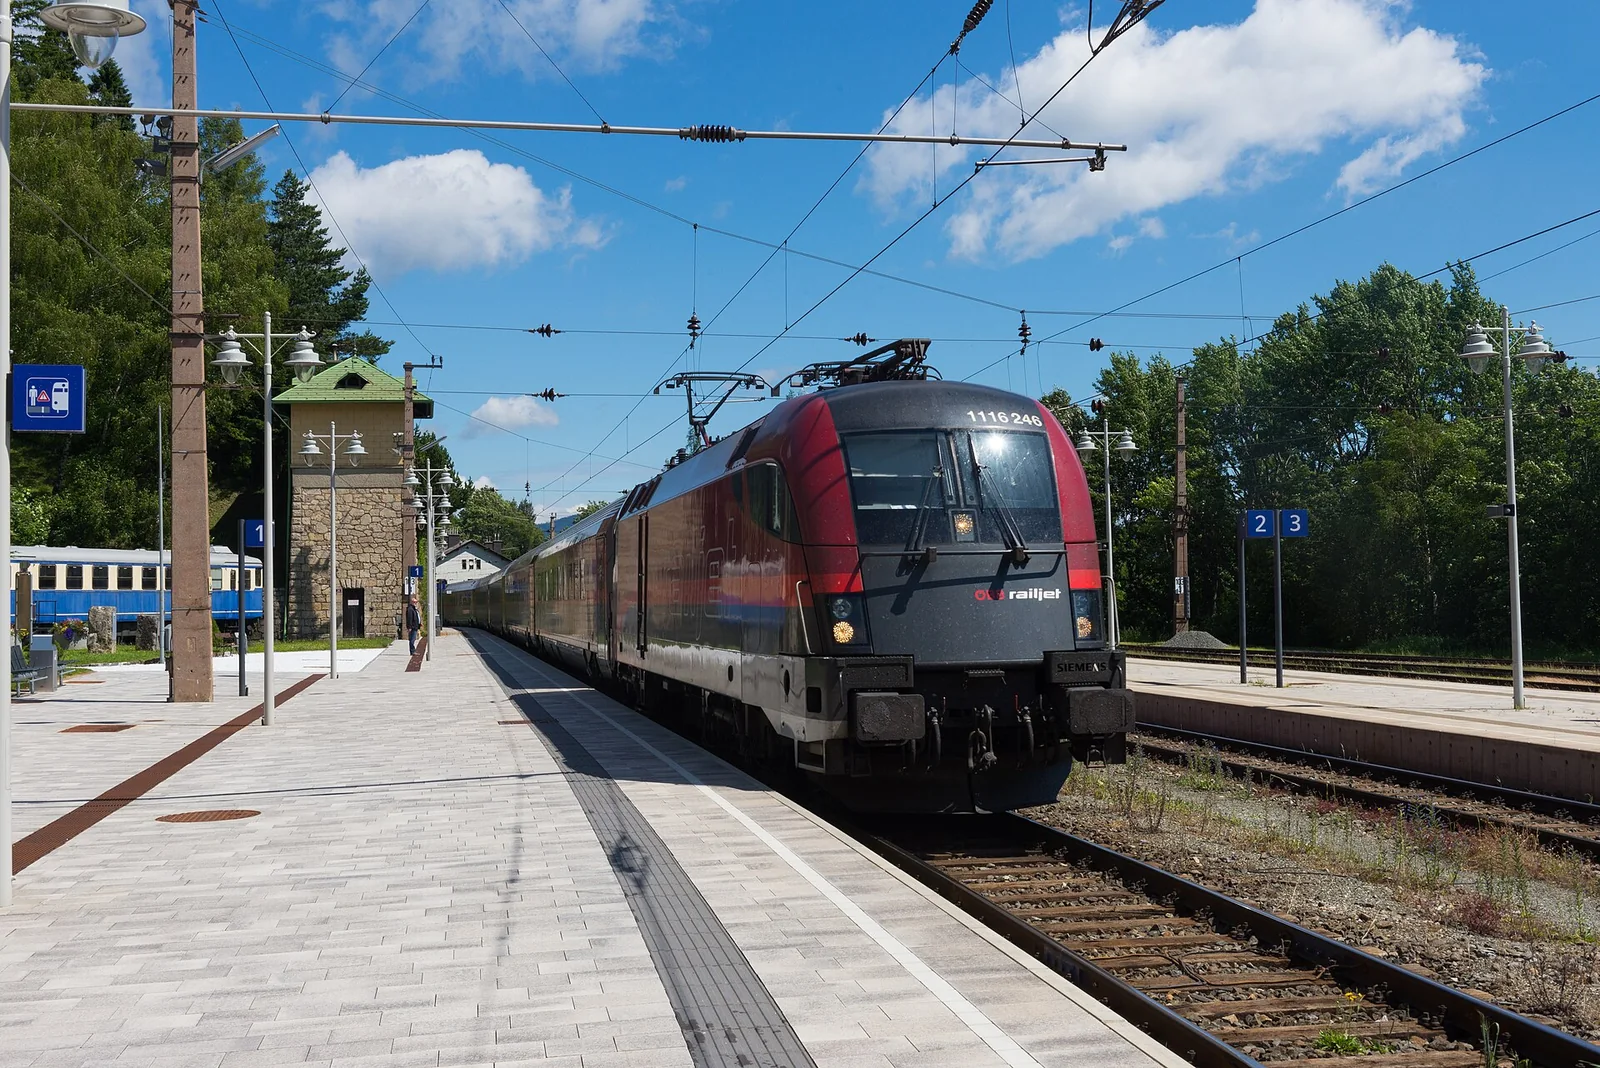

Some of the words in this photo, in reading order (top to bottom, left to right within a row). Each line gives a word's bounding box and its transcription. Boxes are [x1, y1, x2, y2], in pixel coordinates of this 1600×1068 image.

[967, 410, 1009, 423] 1116
[1011, 412, 1043, 427] 246
[1255, 515, 1267, 533] 2
[1289, 514, 1301, 532] 3
[255, 524, 264, 542] 1
[1008, 588, 1062, 602] railjet
[1057, 662, 1107, 673] SIEMENS
